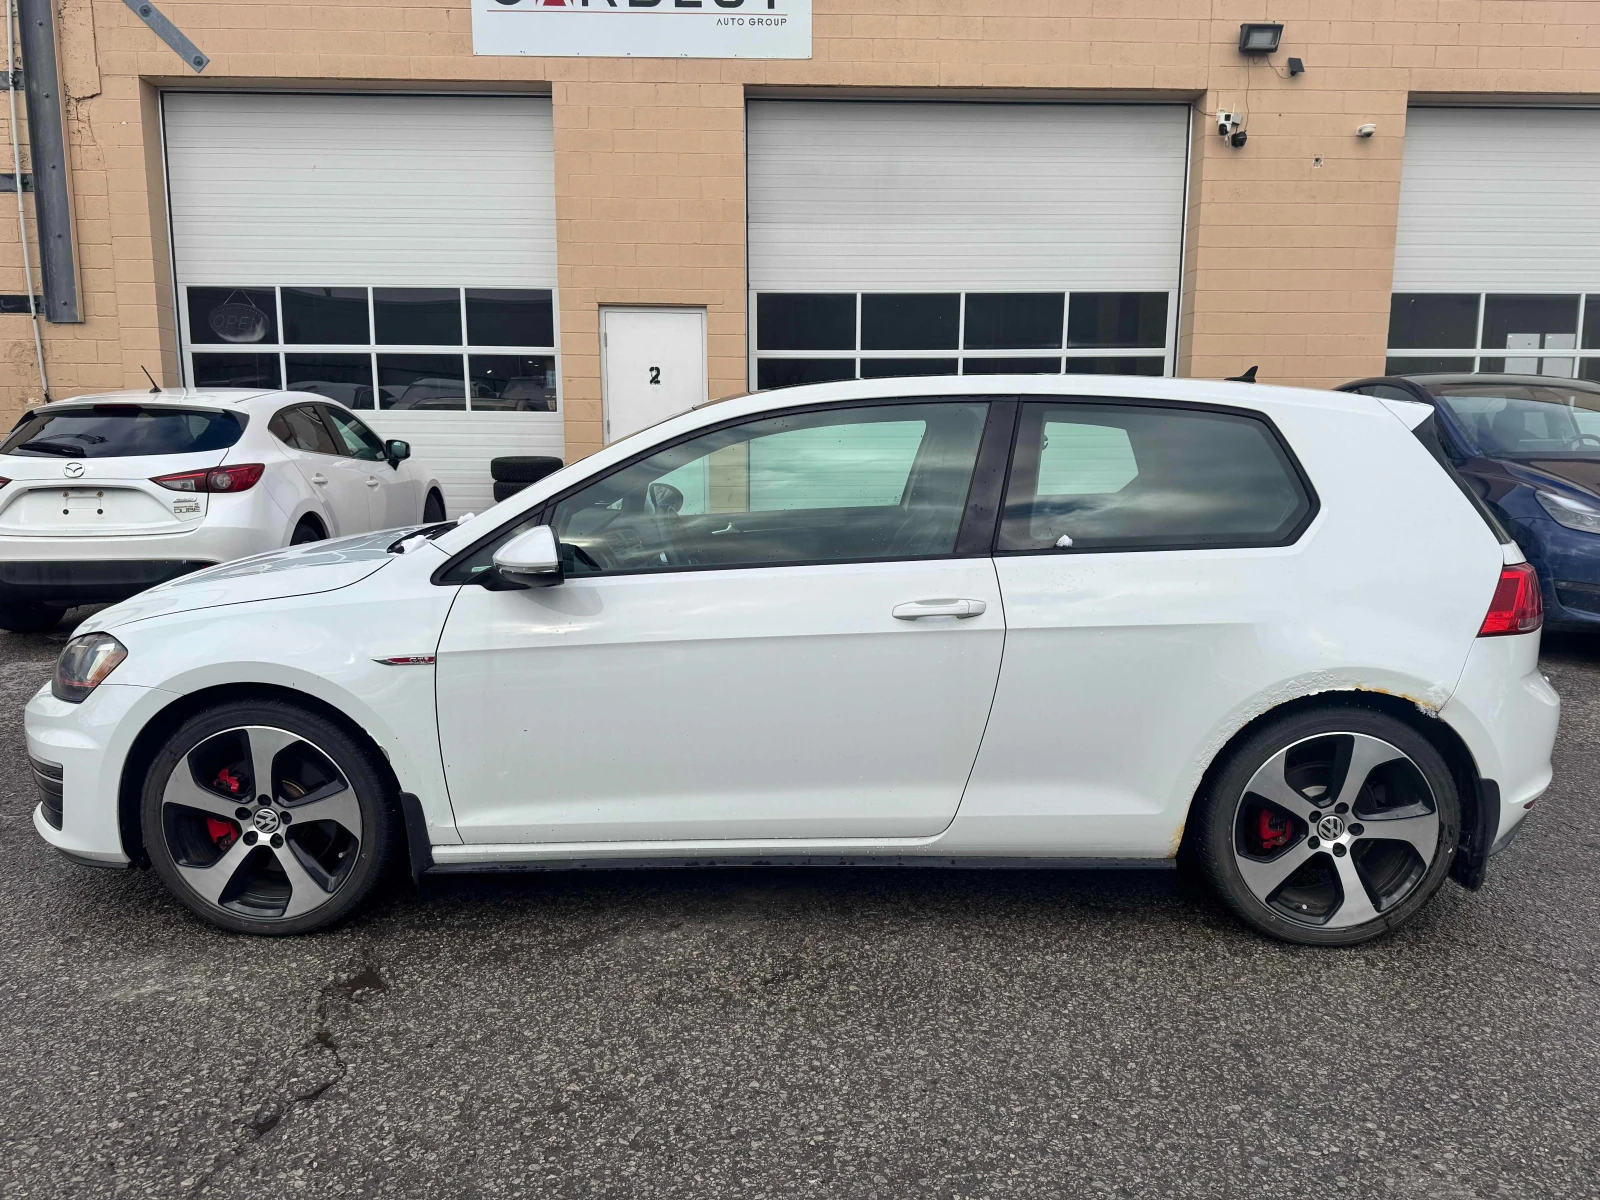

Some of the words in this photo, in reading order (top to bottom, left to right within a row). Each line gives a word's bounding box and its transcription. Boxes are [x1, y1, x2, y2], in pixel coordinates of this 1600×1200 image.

[716, 17, 745, 26] AUTO
[748, 17, 787, 27] GROUP
[649, 366, 661, 385] 2
